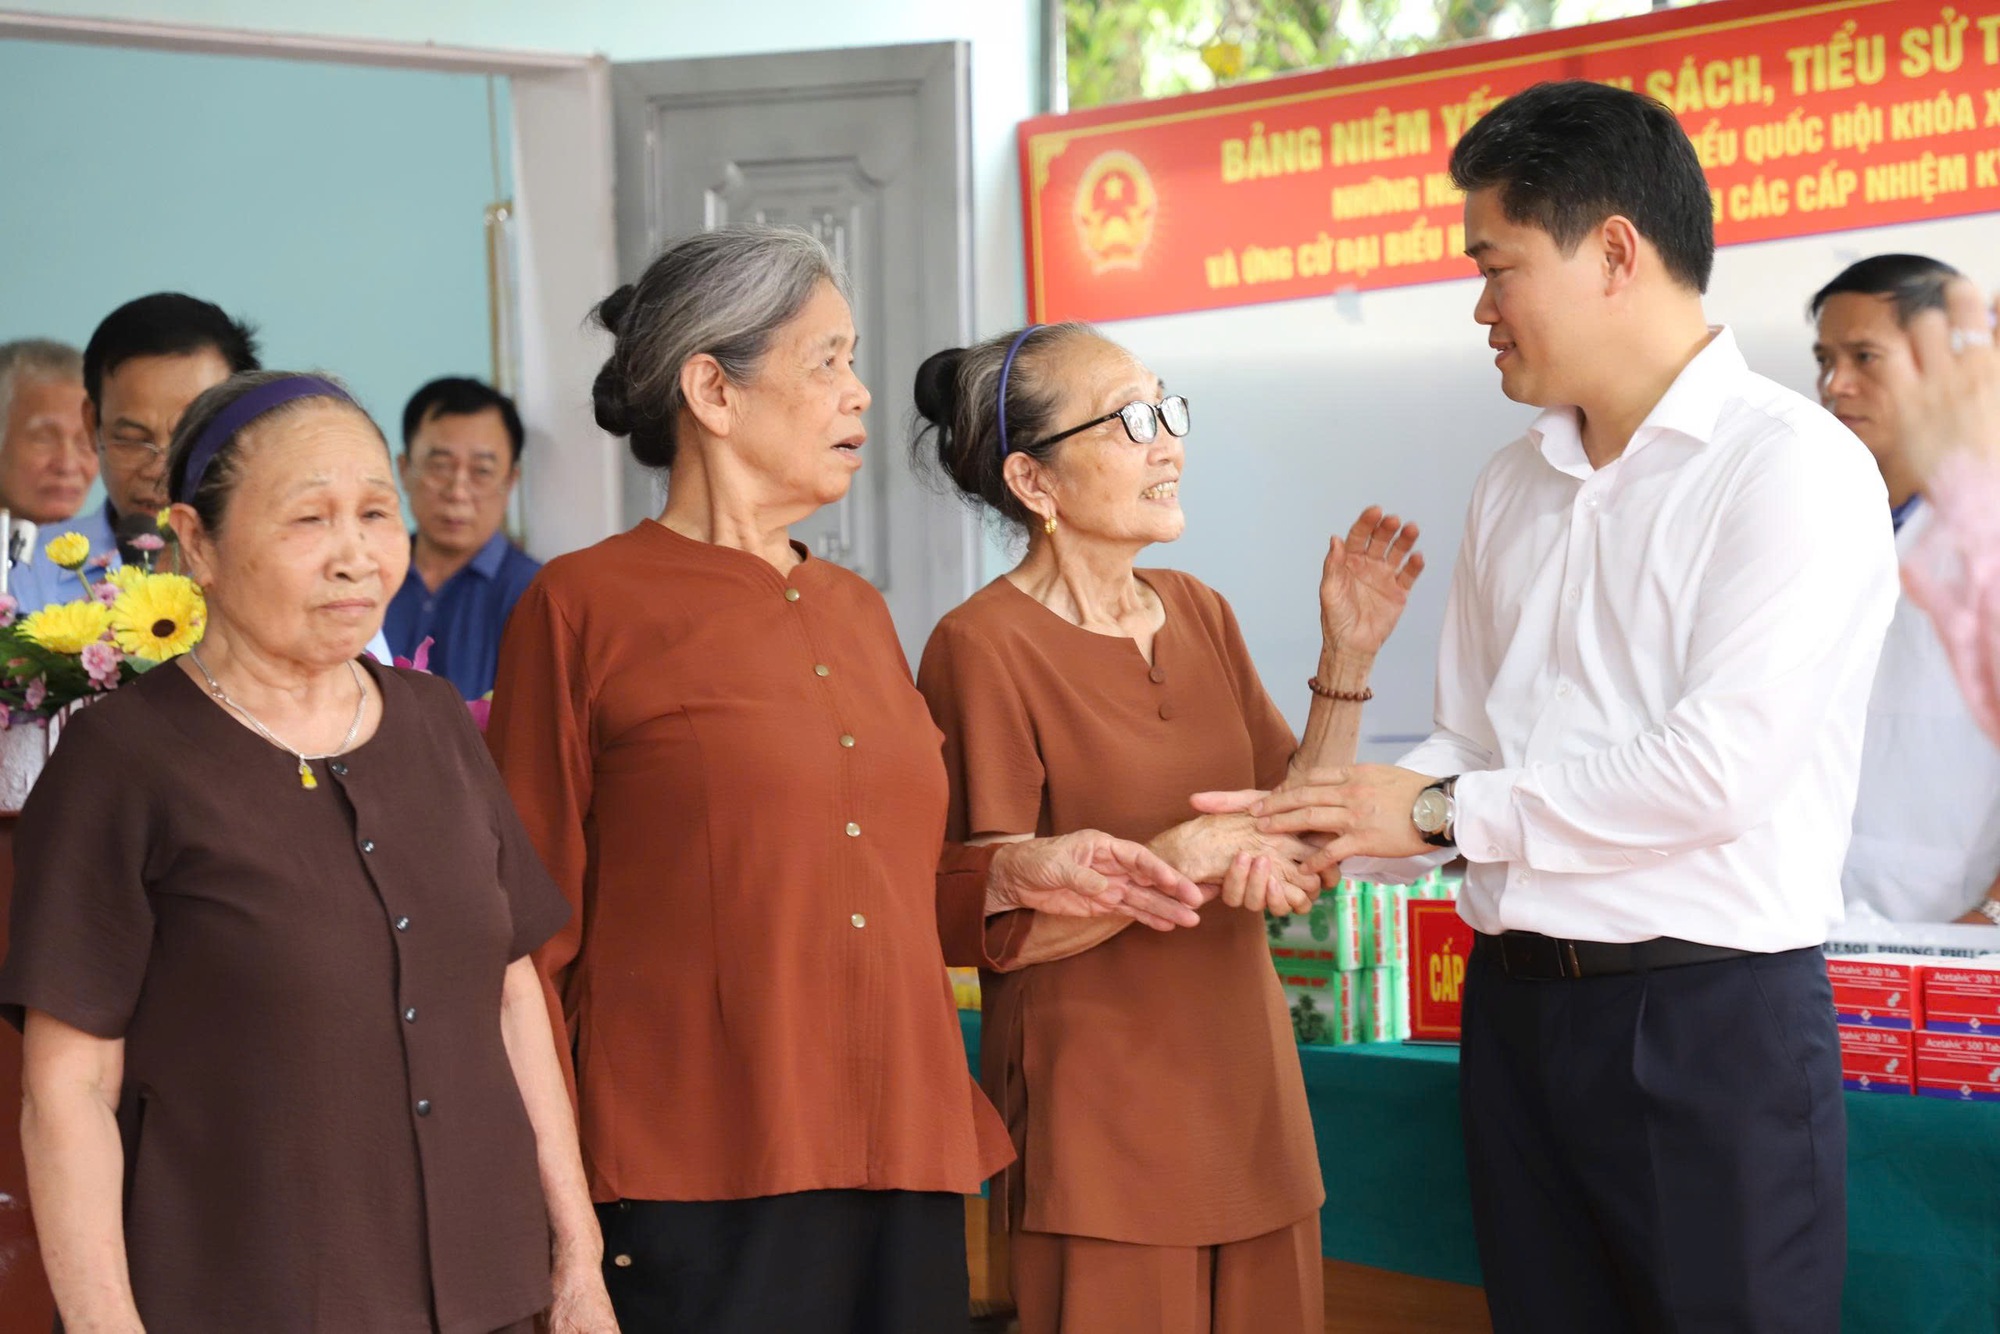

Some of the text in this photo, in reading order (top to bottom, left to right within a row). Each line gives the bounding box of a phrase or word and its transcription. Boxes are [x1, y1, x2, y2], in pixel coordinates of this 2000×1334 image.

[1221, 121, 1323, 183] BẢNG
[1331, 106, 1431, 166] NIÊM
[1441, 85, 1502, 149] YẾ
[1787, 20, 1886, 95] TIỂU
[1901, 6, 1969, 78] SỬ
[1745, 108, 1824, 164] QUỐC
[1832, 102, 1884, 153] HỘI
[1891, 89, 1976, 140] KHÓA
[1205, 247, 1240, 288] VÀ
[1297, 231, 1335, 277] CỬ
[1729, 175, 1790, 221] CÁC
[1797, 160, 1858, 212] CẤP
[1865, 151, 1967, 203] NHIỆM
[1429, 937, 1465, 1002] CẤP
